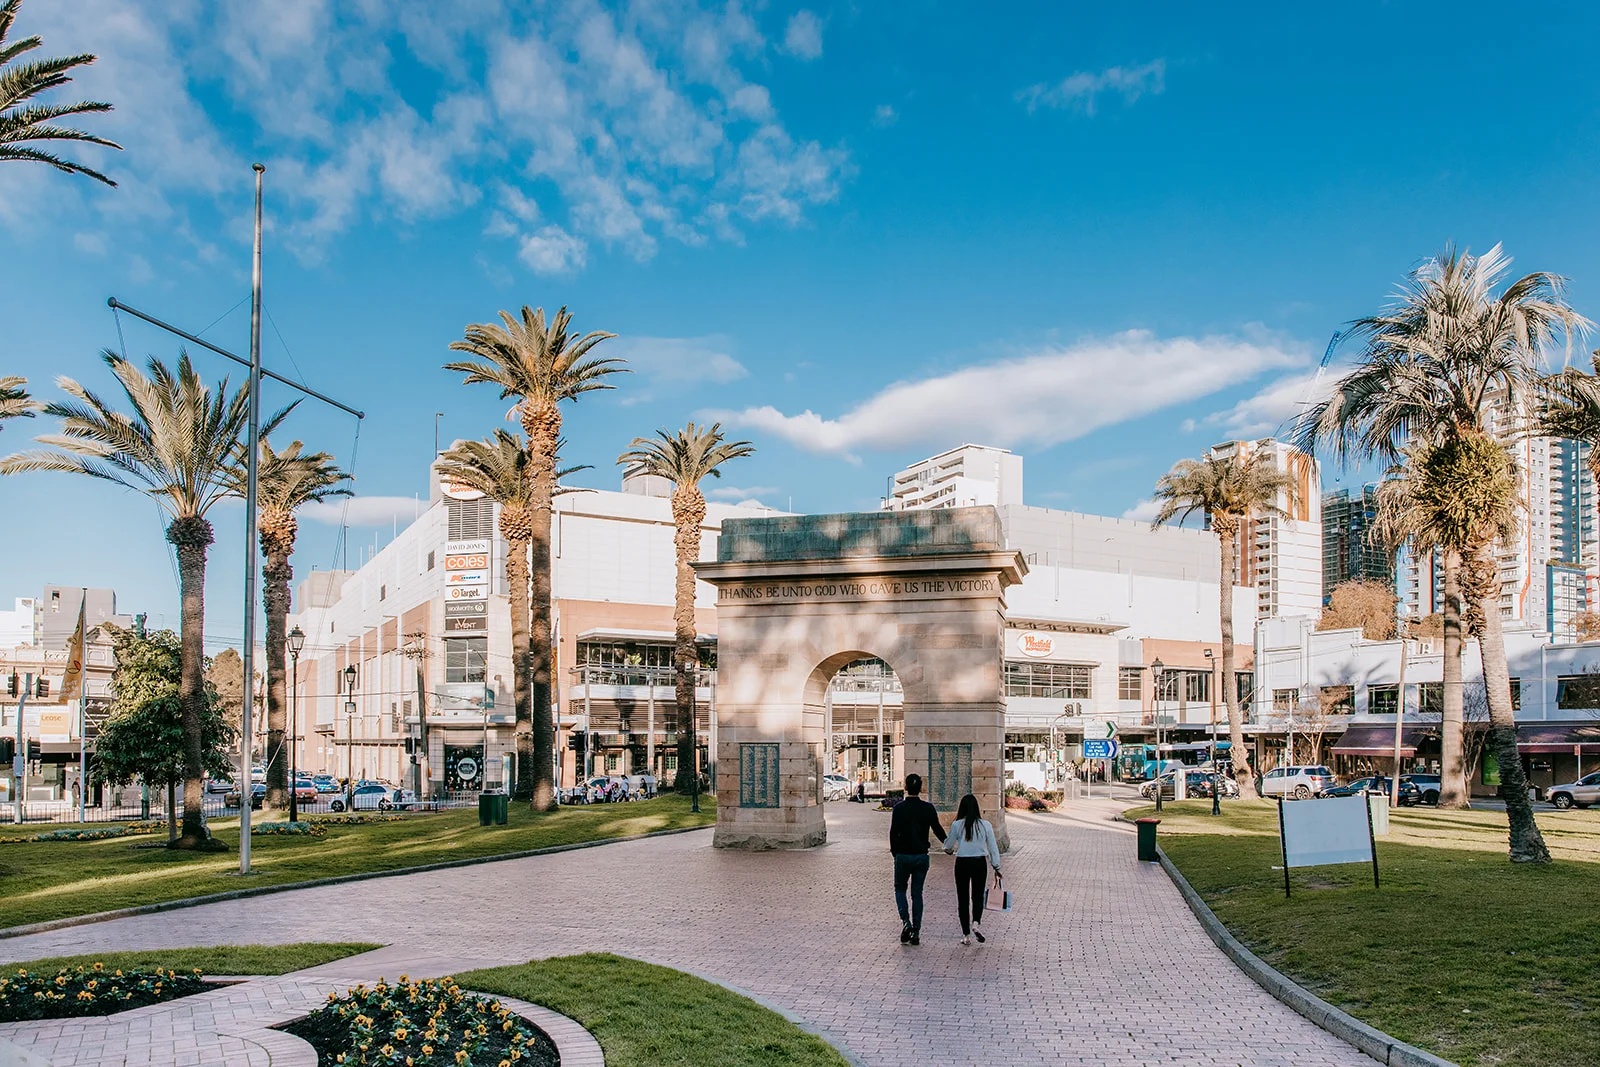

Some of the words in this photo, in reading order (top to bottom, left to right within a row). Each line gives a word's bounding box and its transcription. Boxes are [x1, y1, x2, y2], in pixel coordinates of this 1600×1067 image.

[447, 556, 485, 568] coles
[719, 587, 763, 599] THANKS
[766, 586, 779, 598] BE
[782, 585, 812, 598] UNTO
[814, 584, 837, 597] GOD
[839, 583, 867, 596] WHO
[904, 581, 919, 593] US
[921, 580, 945, 593] THE
[947, 579, 996, 592] VICTORY
